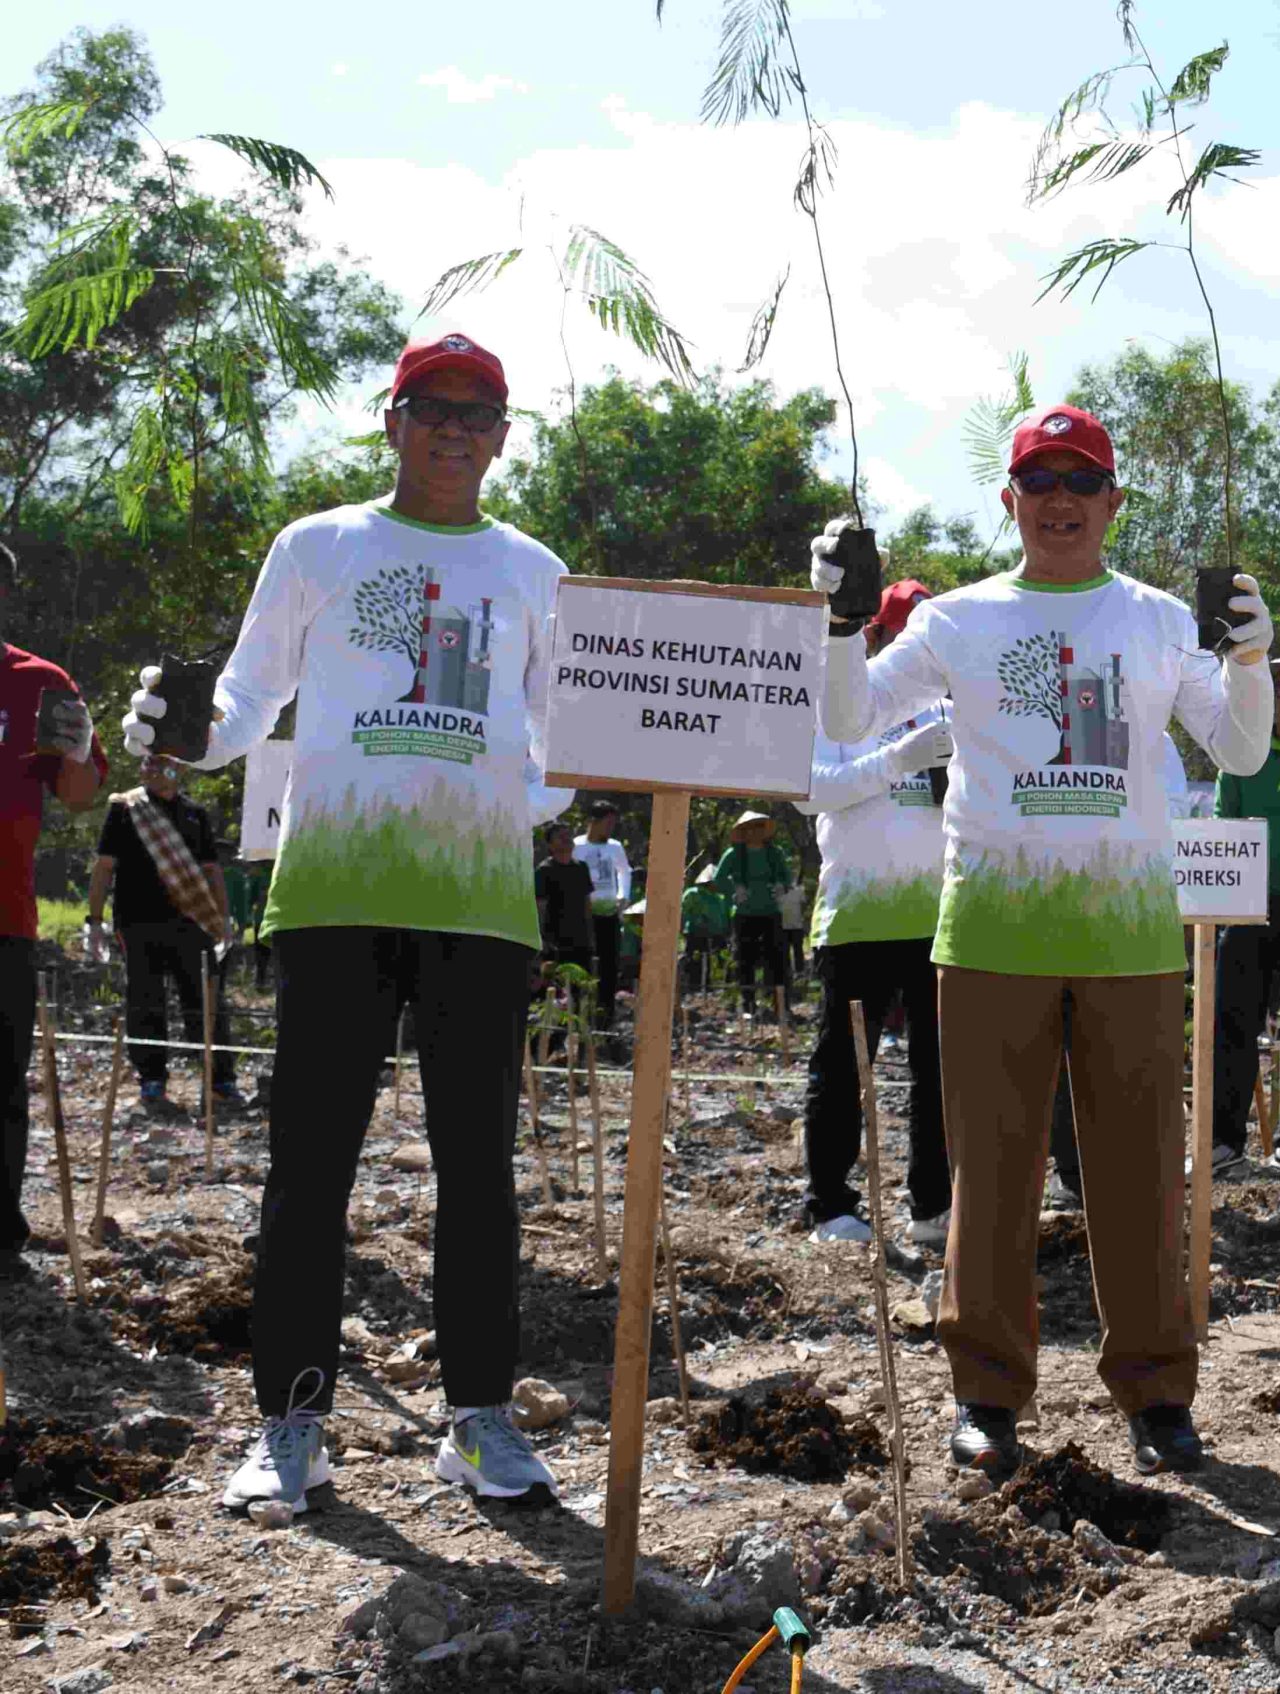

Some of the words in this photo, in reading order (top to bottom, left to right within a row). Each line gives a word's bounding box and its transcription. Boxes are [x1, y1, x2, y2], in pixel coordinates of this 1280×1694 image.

[572, 633, 645, 658] DINAS
[651, 640, 802, 671] KEHUTANAN
[557, 666, 669, 695] PROVINSI
[676, 677, 811, 707] SUMATERA
[354, 709, 485, 738] KALIANDRA
[641, 708, 721, 734] BARAT
[447, 736, 481, 750] DEPAN
[890, 781, 931, 791] KALIA
[1013, 771, 1126, 792] KALIANDRA
[1027, 792, 1063, 801] POHON
[1173, 840, 1260, 858] NASEHAT
[1174, 869, 1241, 887] DIREKSI
